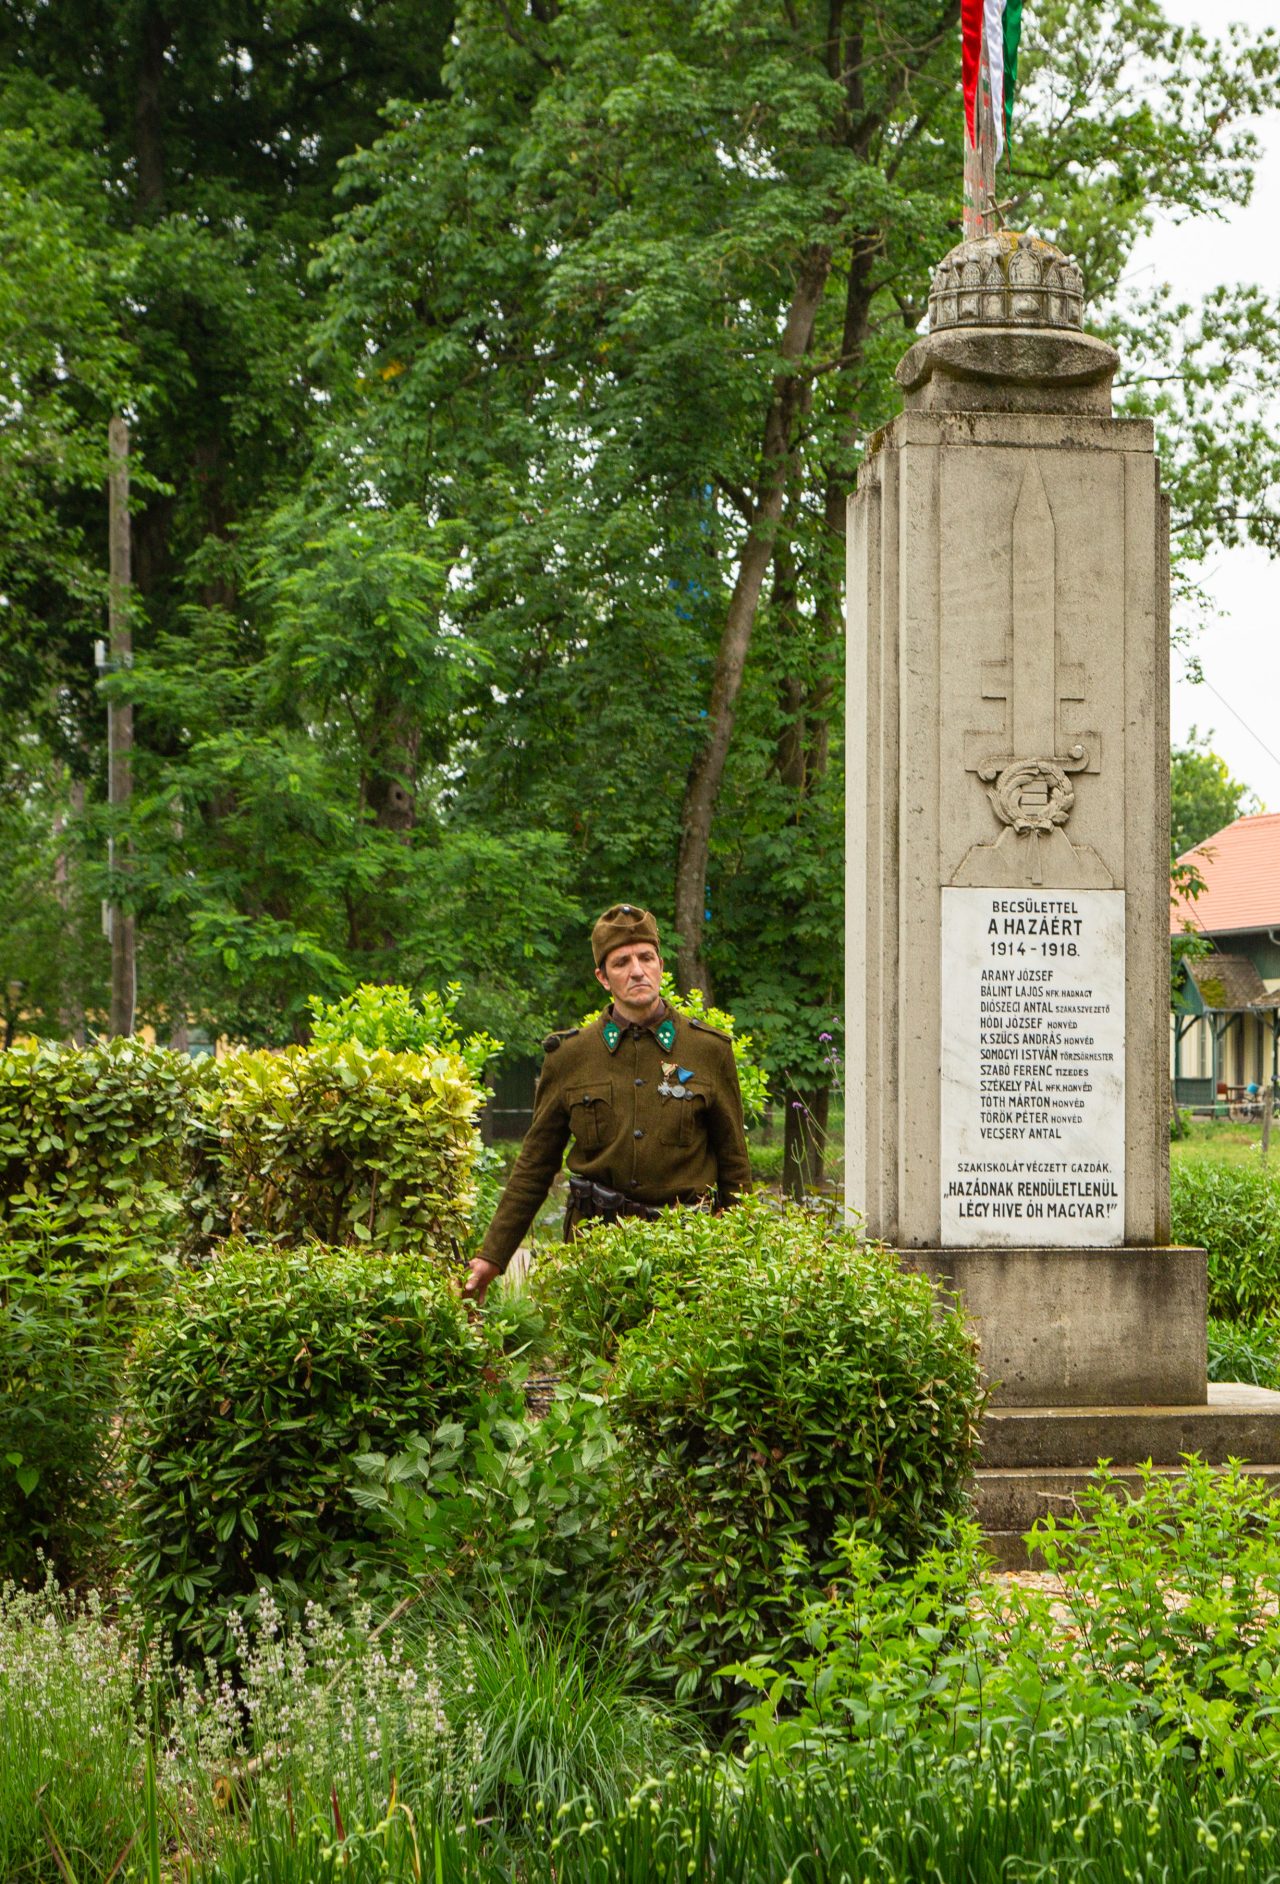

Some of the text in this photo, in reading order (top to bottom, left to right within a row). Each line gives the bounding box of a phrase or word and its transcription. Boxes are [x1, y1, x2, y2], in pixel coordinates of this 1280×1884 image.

[992, 897, 1079, 914] BECSÜLETTEL
[987, 915, 1083, 936] A HAZÁÉRT
[980, 967, 1054, 981] ARANY JÓZSEF
[980, 984, 1013, 997] BÁLINT
[1015, 985, 1044, 997] LAJOS
[980, 999, 1021, 1013] DIÓSZEGI
[1023, 1001, 1054, 1013] ANTAL
[979, 1015, 1079, 1029] HÓDI JÓZSEF HONVÉD
[1022, 1030, 1062, 1045] ANDRÁS
[1063, 1036, 1095, 1046] HONVÉD
[979, 1048, 1020, 1061] SOMOGYI
[1021, 1046, 1058, 1061] ISTVÁN
[979, 1063, 1089, 1077] SZABÓ FERENC TIZEDES
[979, 1079, 1023, 1092] SZÉKELY
[1024, 1079, 1044, 1092] PÁL
[980, 1093, 1085, 1108] TÓTH MÁRTON HONVÉD
[979, 1110, 1083, 1124] TÖRÖK PÉTER HONVÉD
[979, 1128, 1062, 1140] VECSERY ANTAL
[956, 1160, 1113, 1174] SZAKISKOLÁT VÉGZETT GAZDÁK.
[1017, 1178, 1119, 1197] RENDÜLETLENÜL
[958, 1199, 990, 1218] LÉGY
[992, 1203, 1023, 1218] HIVE
[1025, 1200, 1044, 1218] ÓH
